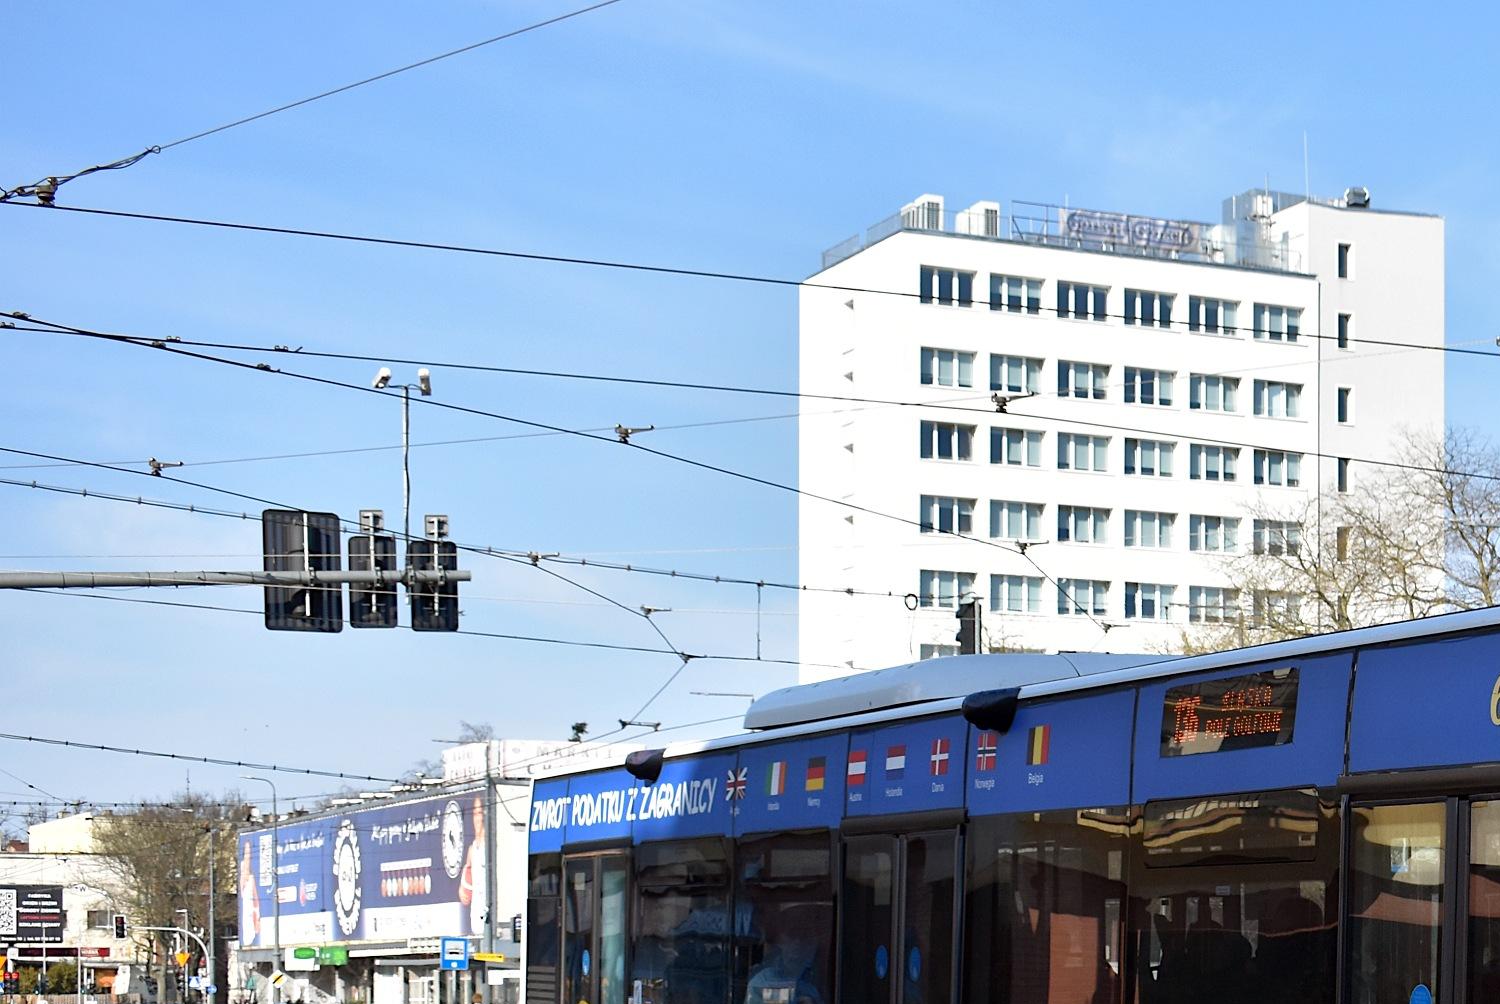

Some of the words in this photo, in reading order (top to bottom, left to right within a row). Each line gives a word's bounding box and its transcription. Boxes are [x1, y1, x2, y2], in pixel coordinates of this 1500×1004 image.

[531, 797, 571, 831] ZWROT
[572, 790, 625, 826] PODATKU
[639, 777, 717, 820] ZAGRANICY
